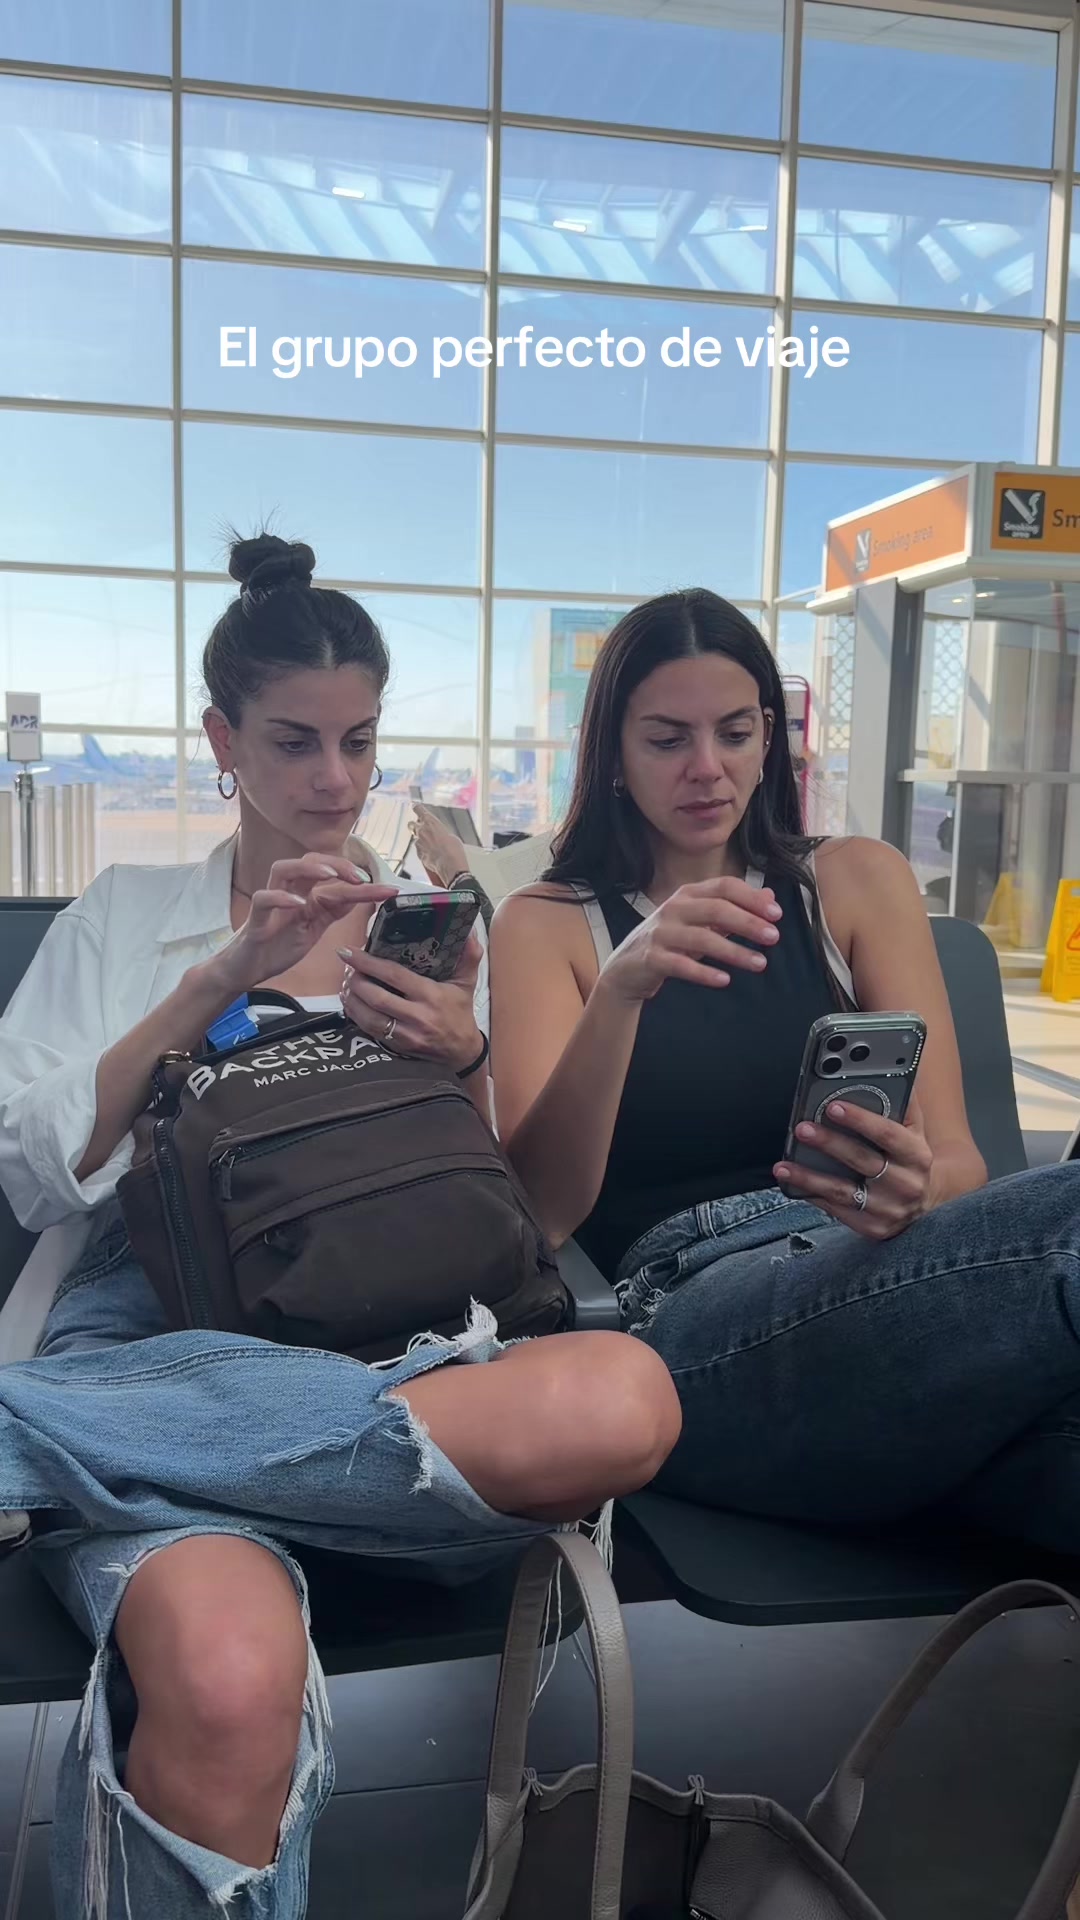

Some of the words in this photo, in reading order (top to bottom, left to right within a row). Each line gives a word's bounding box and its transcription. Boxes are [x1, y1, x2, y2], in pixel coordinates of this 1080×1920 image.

[1003, 521, 1040, 535] Smoking
[253, 1029, 344, 1056] THE
[187, 1036, 380, 1100] BACKPA
[253, 1067, 313, 1088] MARC
[316, 1053, 393, 1073] JACOBS
